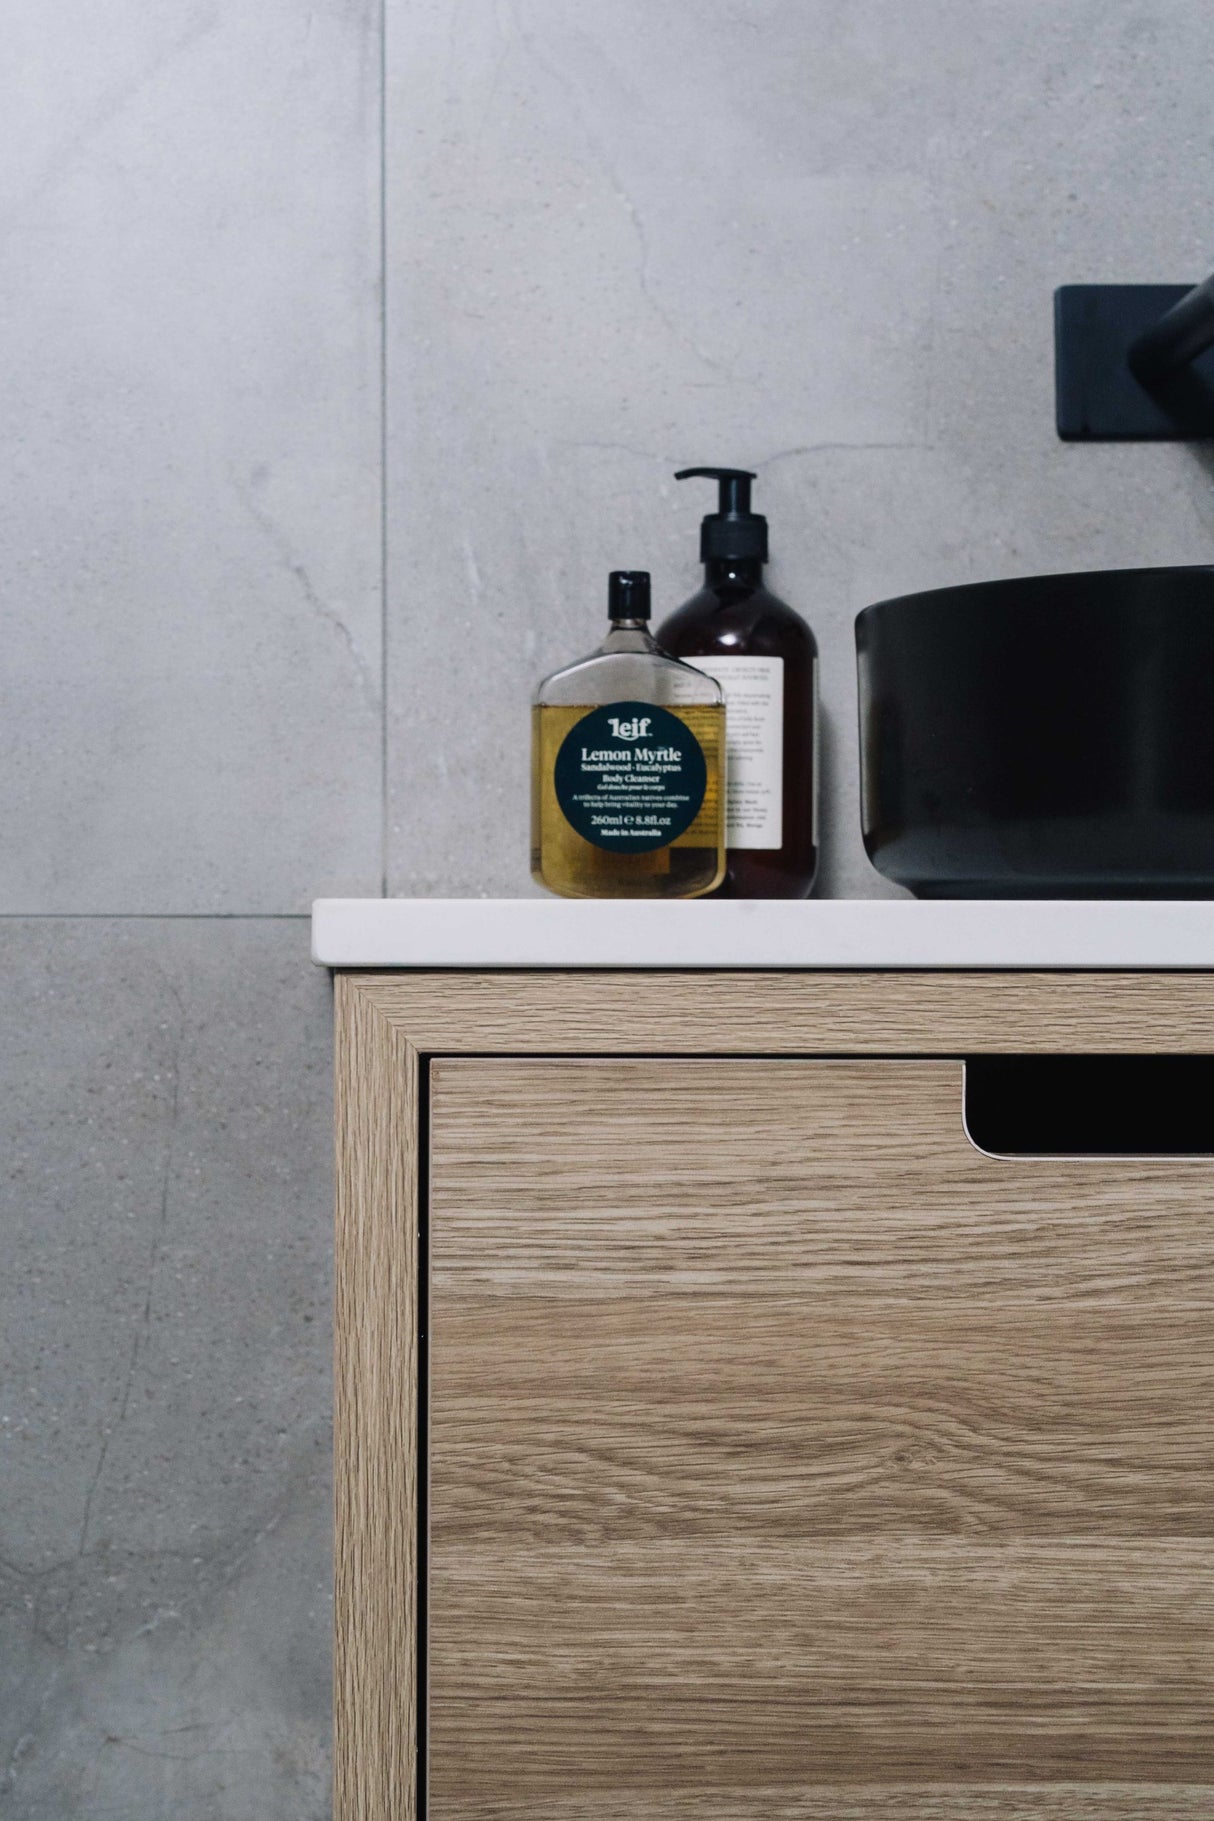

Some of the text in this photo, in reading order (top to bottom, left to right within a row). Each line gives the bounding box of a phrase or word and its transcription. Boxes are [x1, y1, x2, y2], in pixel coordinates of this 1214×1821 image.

[581, 747, 682, 763] Lemon Myrtle
[581, 763, 681, 773] Sandalwood Eucalyptus
[602, 774, 660, 783] Body Cleanser
[591, 815, 622, 825] 260ml
[635, 815, 671, 825] 8.8fl.oz
